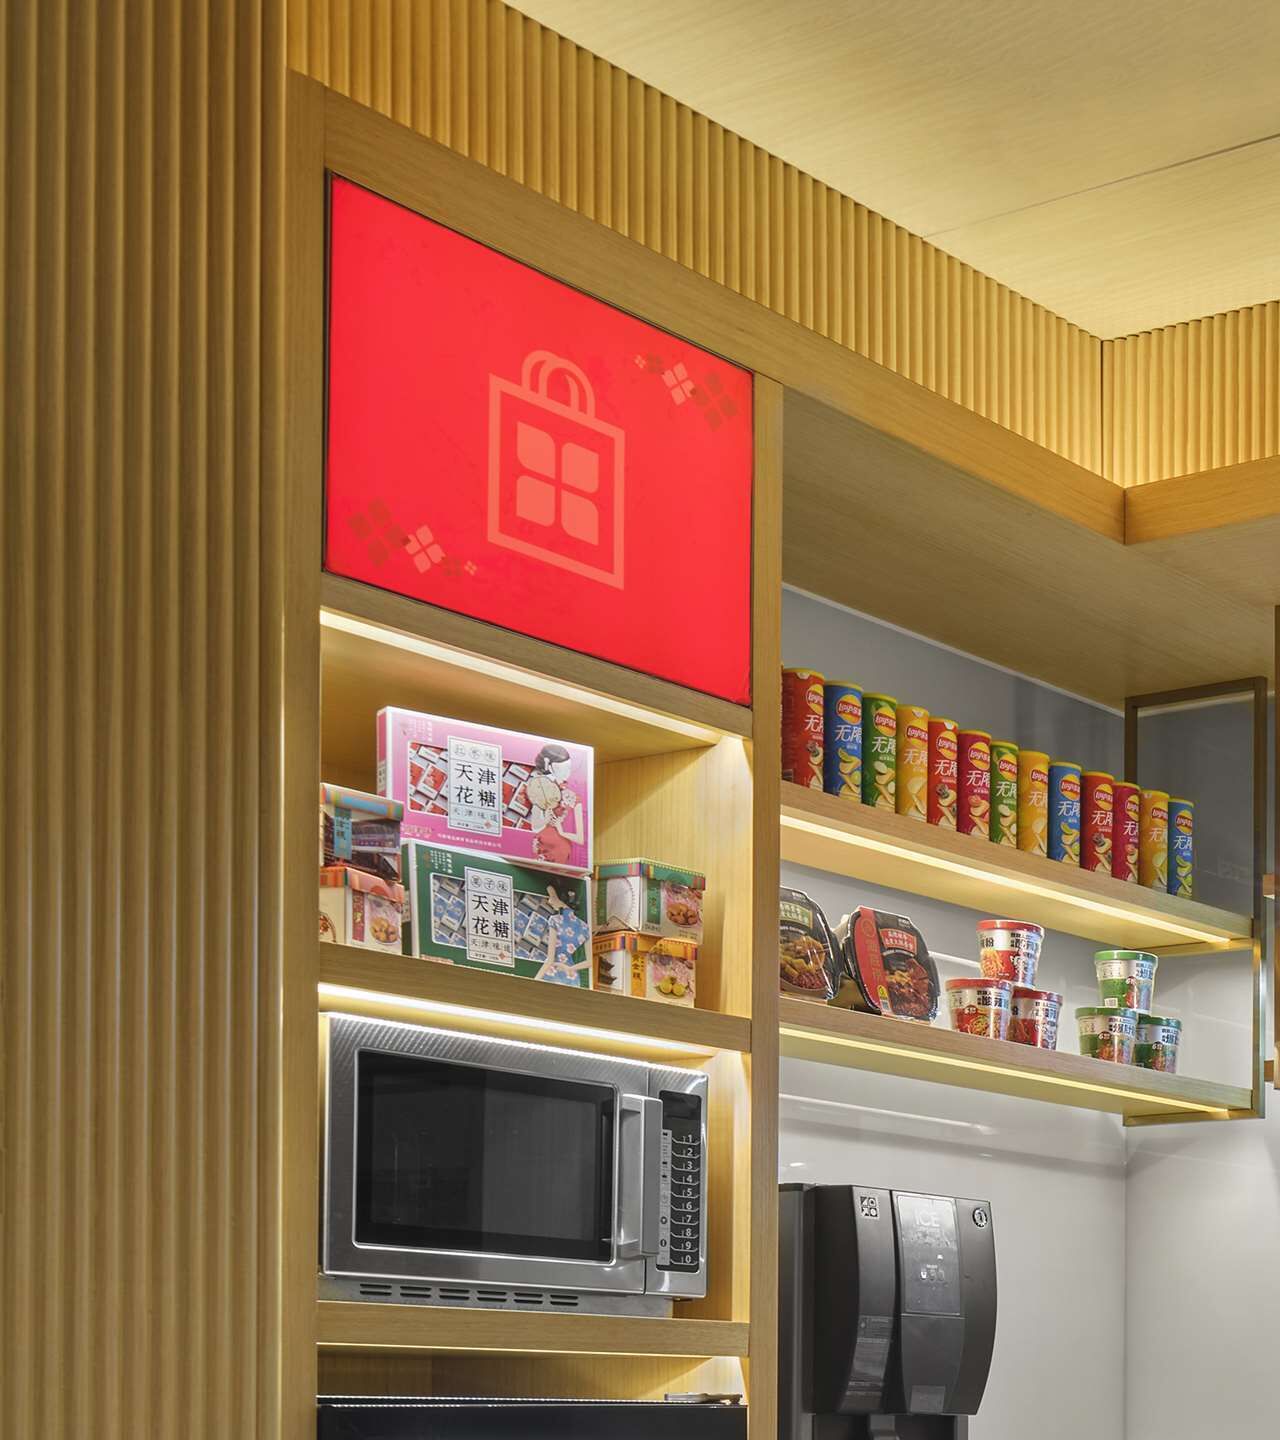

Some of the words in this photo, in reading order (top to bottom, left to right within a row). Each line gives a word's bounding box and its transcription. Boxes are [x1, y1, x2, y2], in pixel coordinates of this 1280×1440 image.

[453, 762, 498, 786] 天津
[453, 784, 497, 808] 花糖
[471, 894, 510, 916] 天津
[471, 915, 510, 939] 花糖
[914, 1211, 940, 1228] ICE
